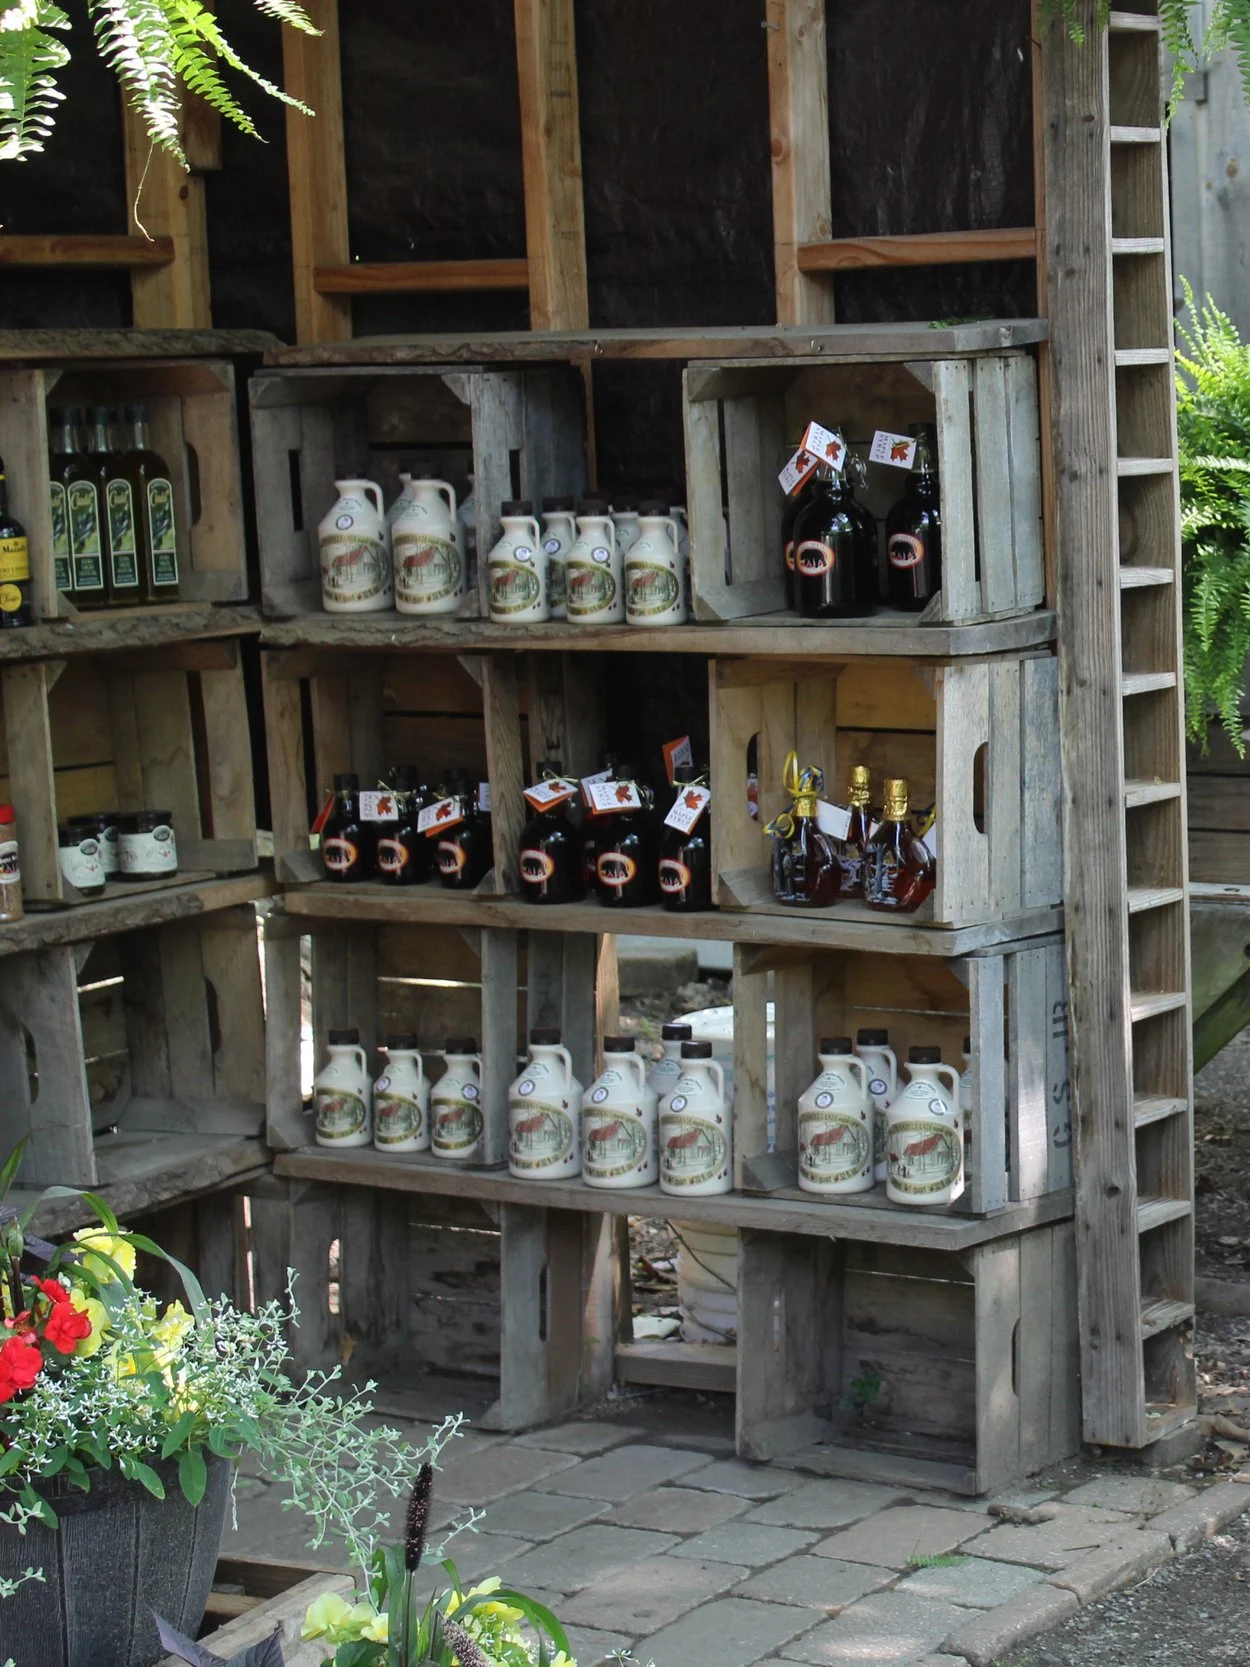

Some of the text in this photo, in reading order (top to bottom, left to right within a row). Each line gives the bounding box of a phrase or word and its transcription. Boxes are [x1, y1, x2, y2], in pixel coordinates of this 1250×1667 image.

[875, 433, 884, 459] SYRUP
[880, 435, 889, 459] MAPLE
[670, 814, 690, 825] SYRUP
[673, 809, 692, 820] MAPLE
